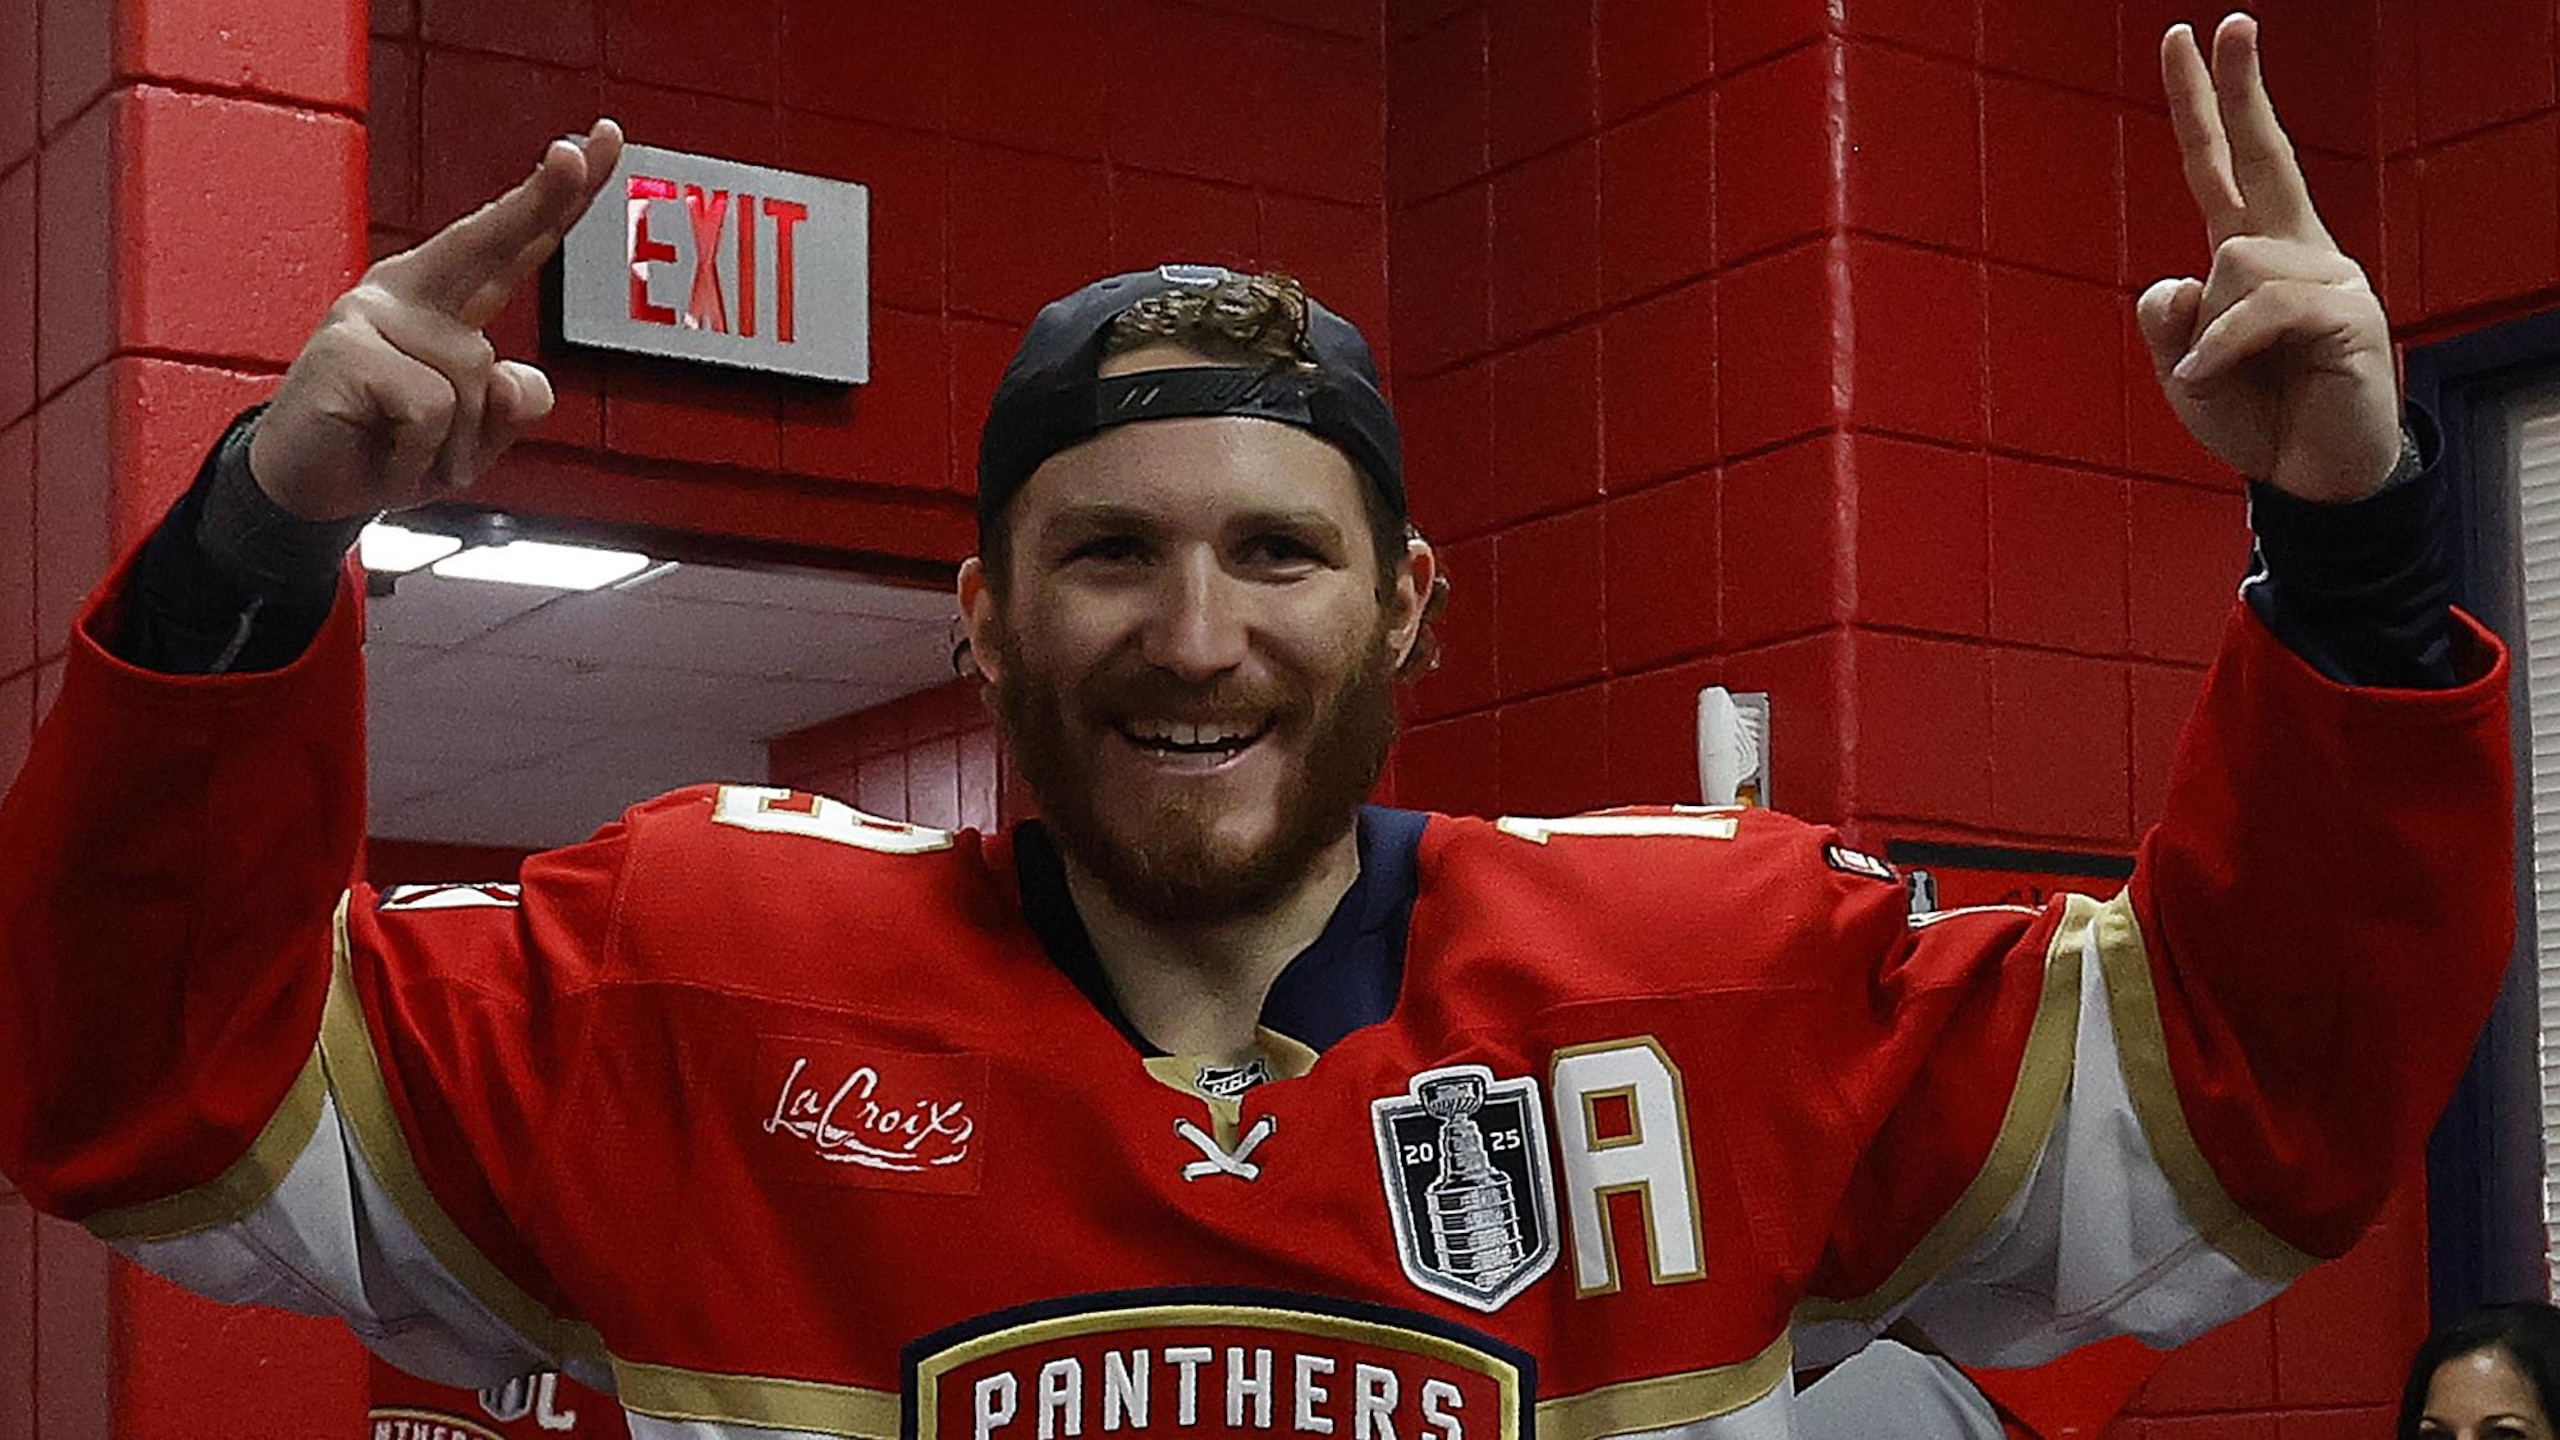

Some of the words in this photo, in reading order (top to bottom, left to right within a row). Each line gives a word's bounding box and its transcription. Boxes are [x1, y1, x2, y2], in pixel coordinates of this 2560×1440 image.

[626, 175, 809, 343] EXIT
[763, 1058, 974, 1152] LaCroix
[1403, 1142, 1434, 1165] 20
[1489, 1128, 1521, 1151] 25
[1550, 1034, 1707, 1300] A
[974, 1346, 1465, 1440] PANTHERS
